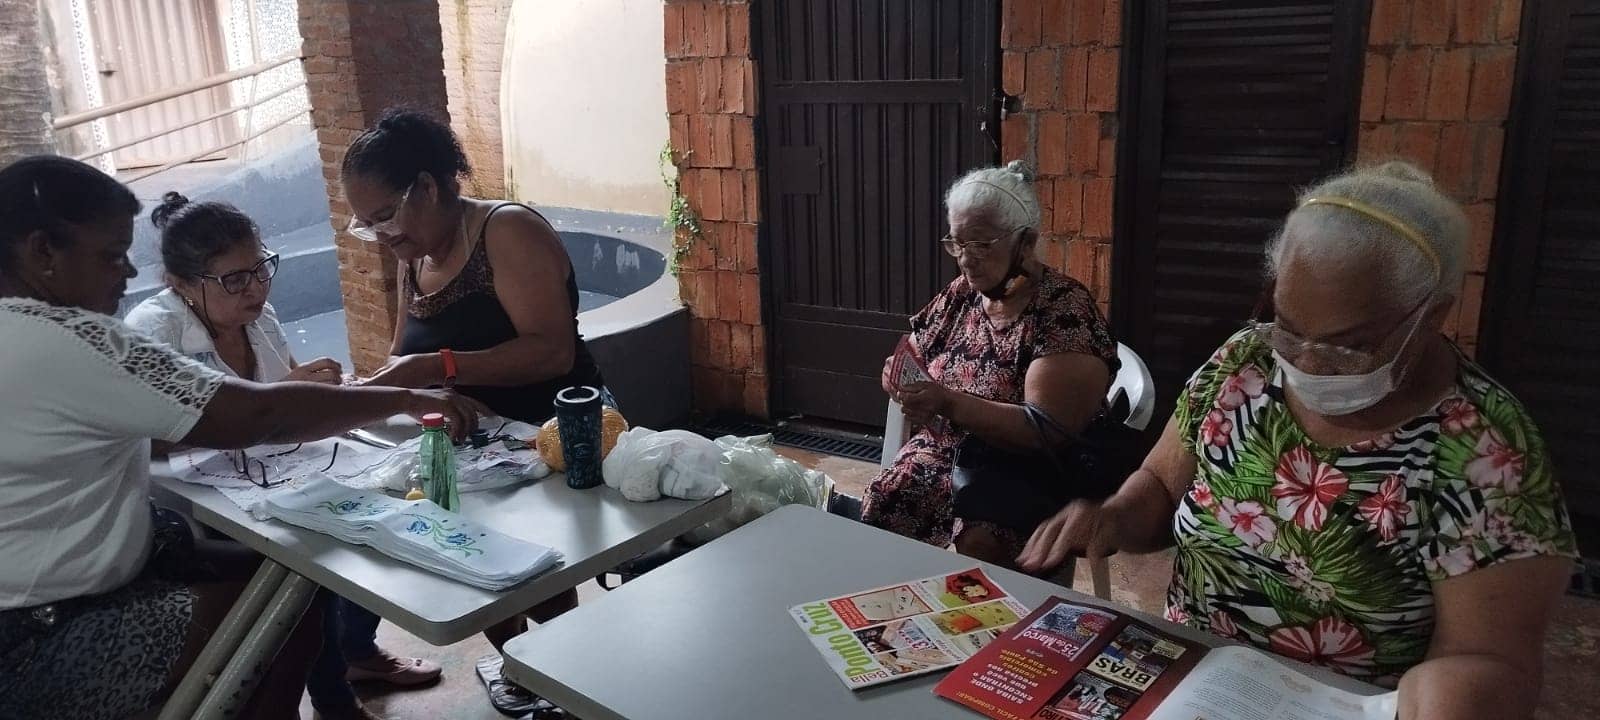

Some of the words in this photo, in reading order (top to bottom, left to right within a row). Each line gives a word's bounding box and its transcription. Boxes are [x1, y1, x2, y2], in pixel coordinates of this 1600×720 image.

[802, 602, 843, 635] Cruz
[827, 633, 880, 677] Ponto
[1061, 643, 1080, 656] 25
[850, 670, 888, 683] Bella
[971, 678, 994, 691] ONDE
[980, 675, 1034, 701] ENCONTRAR
[996, 689, 1024, 704] SAIBA
